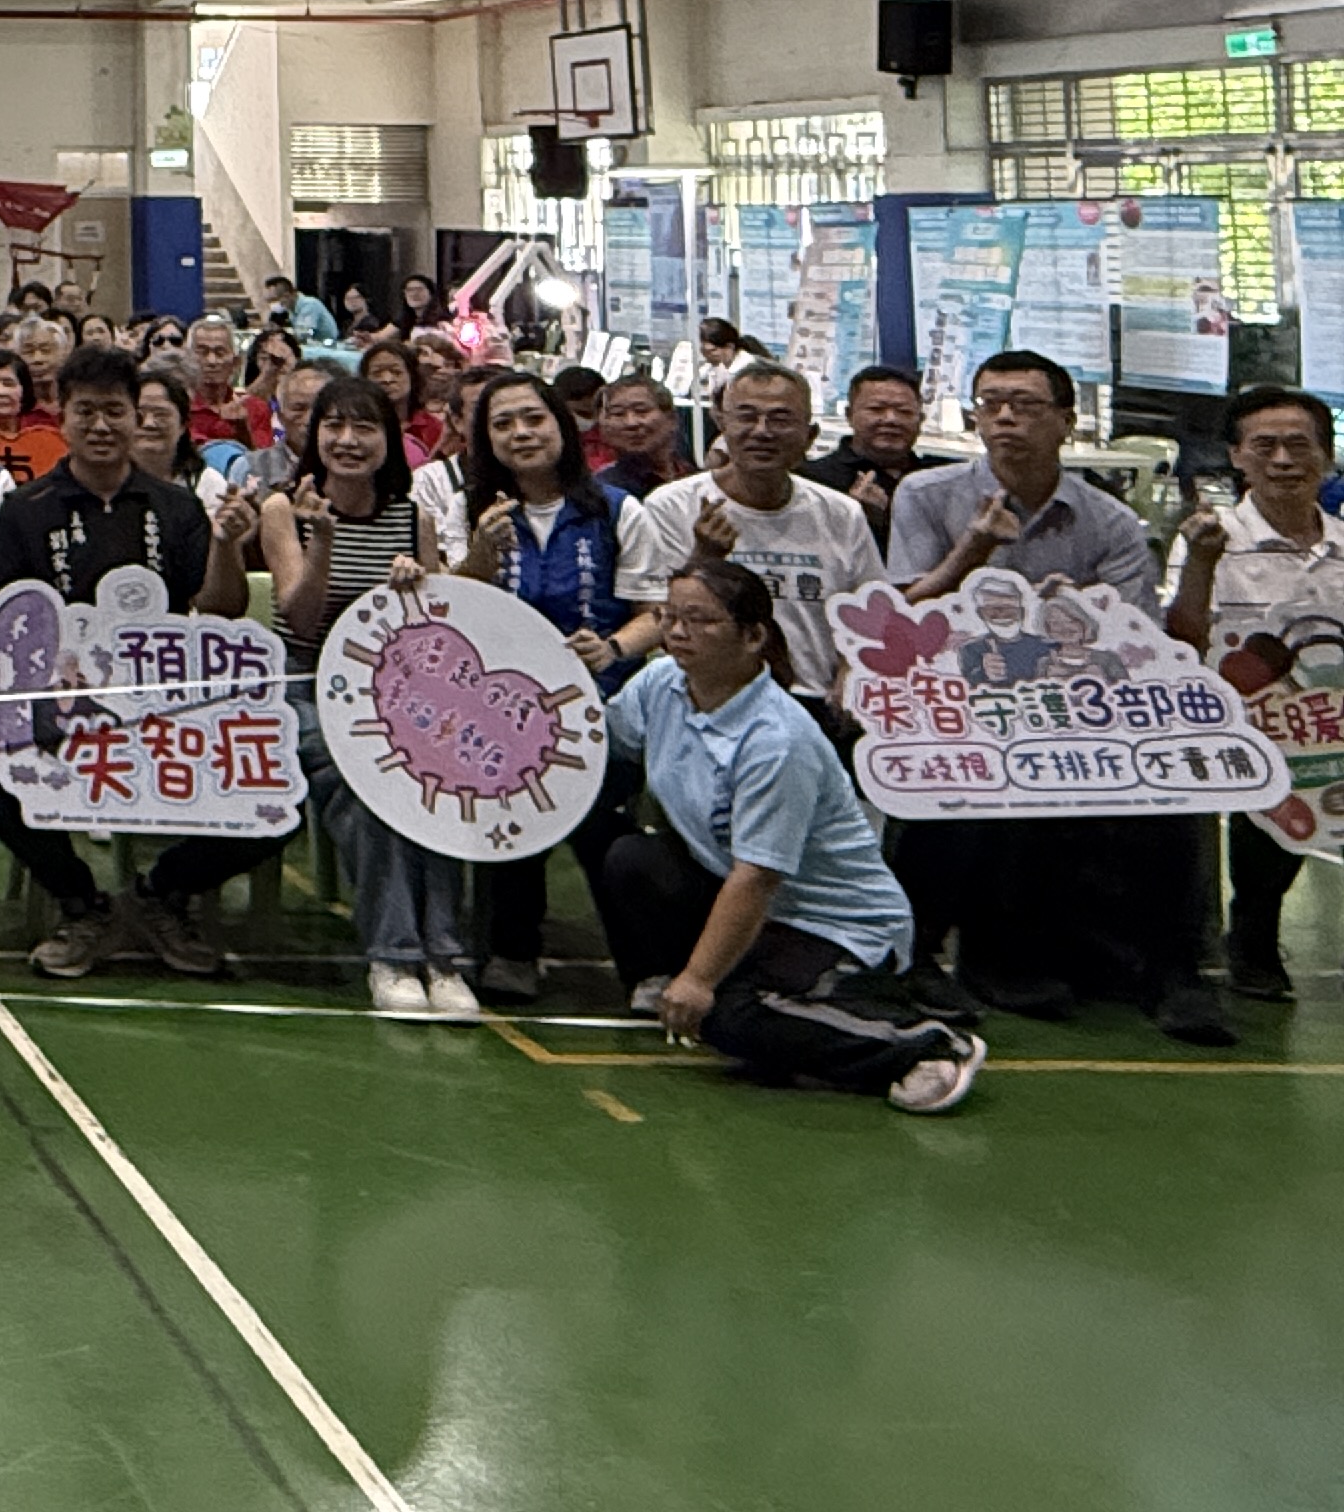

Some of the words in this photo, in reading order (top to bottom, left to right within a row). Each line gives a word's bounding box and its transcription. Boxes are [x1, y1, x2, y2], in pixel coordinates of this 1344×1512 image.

[118, 631, 268, 701] 預防
[859, 669, 1226, 737] 失智守護3部曲
[65, 710, 290, 803] 失智症
[882, 752, 995, 784] 不歧視
[1015, 748, 1127, 781] 不排斥
[1139, 744, 1258, 782] 不責備
